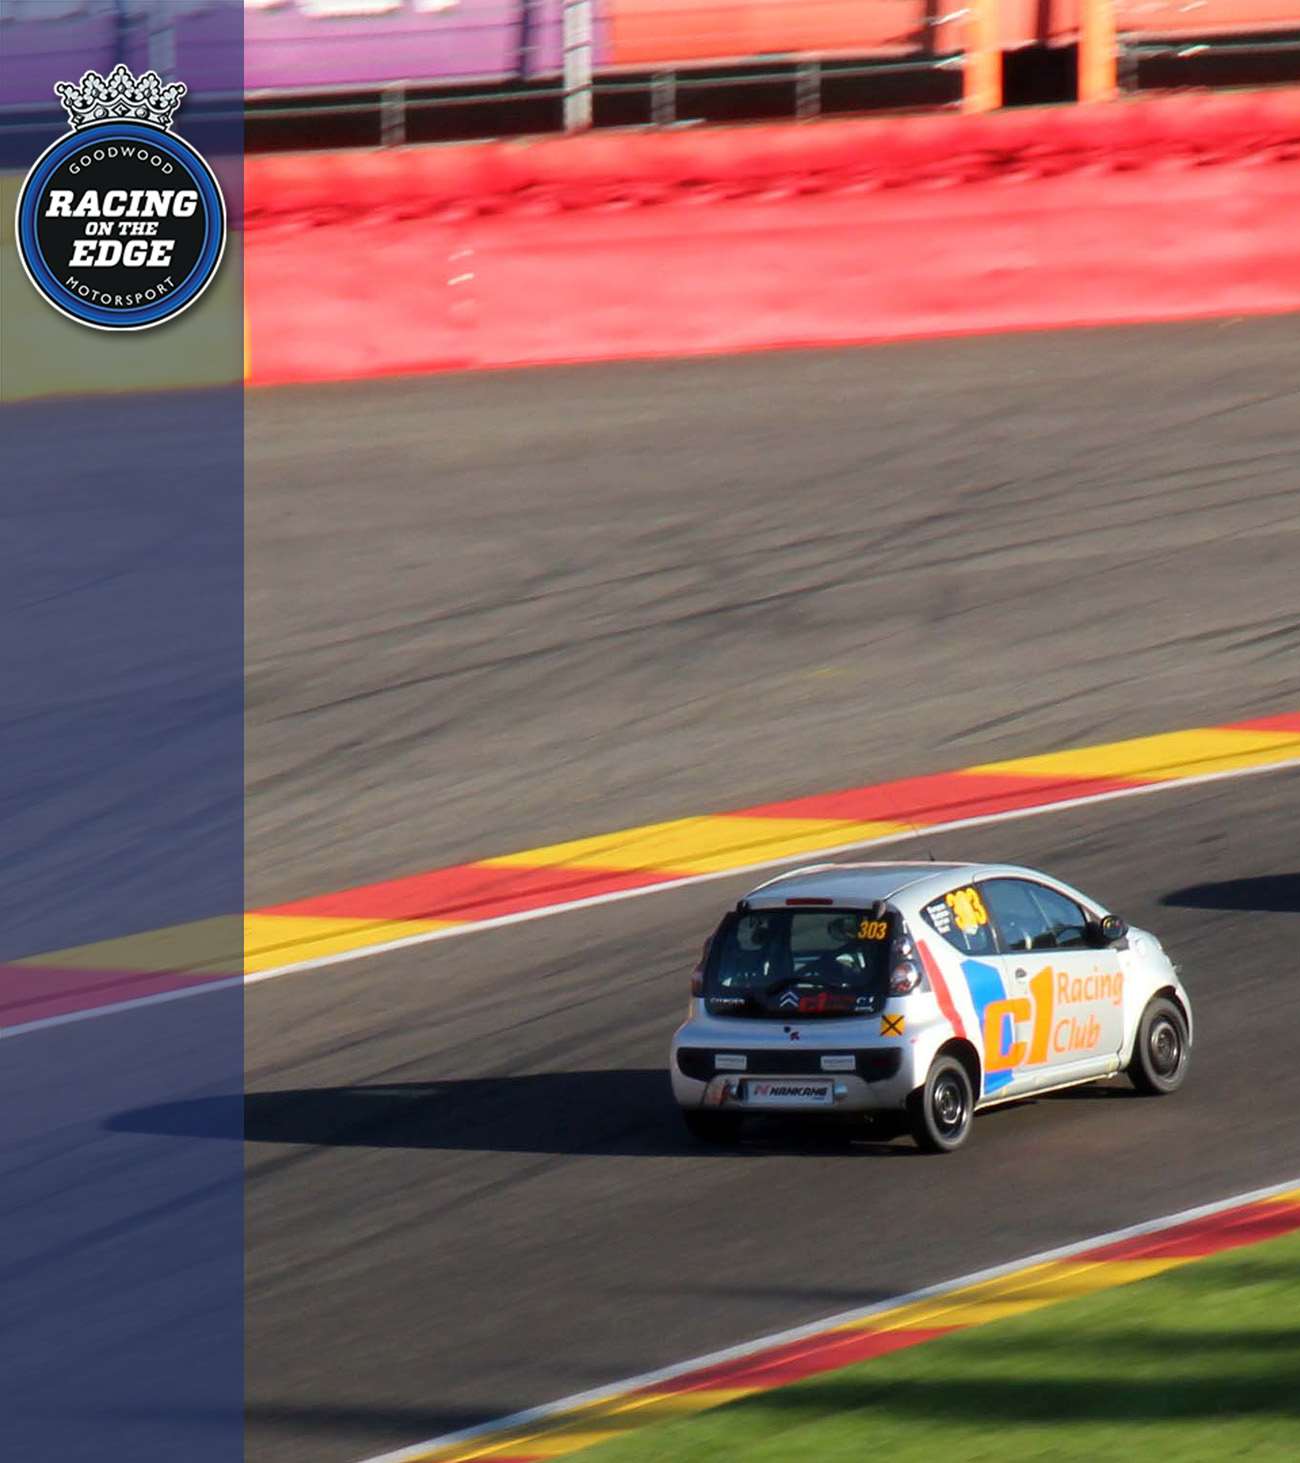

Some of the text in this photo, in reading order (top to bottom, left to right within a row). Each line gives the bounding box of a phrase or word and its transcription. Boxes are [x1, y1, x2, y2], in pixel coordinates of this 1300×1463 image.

[946, 887, 988, 931] 303
[857, 922, 888, 941] 303
[1057, 969, 1124, 1008] Racing
[1054, 1015, 1101, 1053] Club
[769, 1086, 828, 1097] NANKANG
